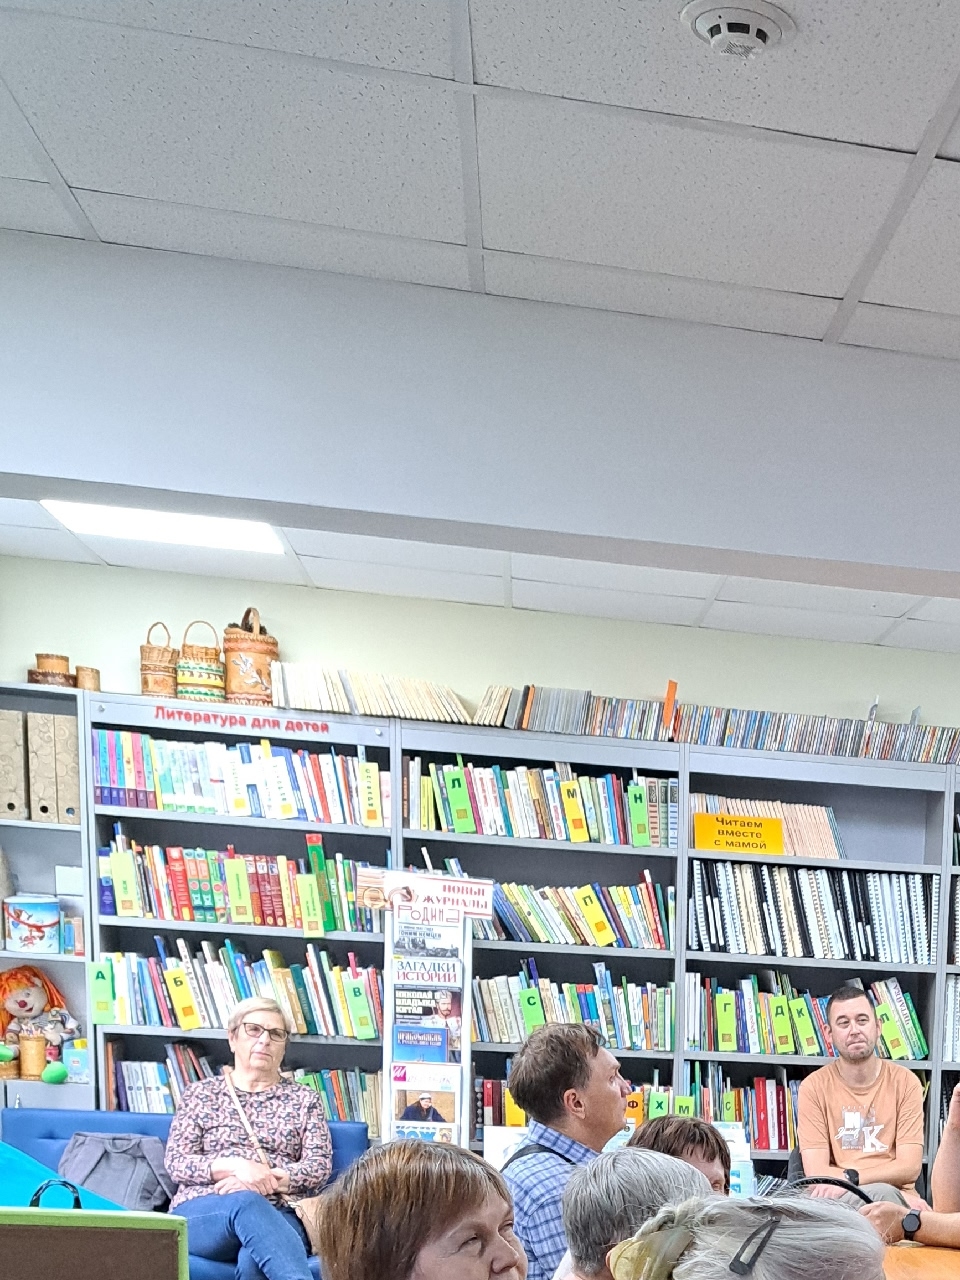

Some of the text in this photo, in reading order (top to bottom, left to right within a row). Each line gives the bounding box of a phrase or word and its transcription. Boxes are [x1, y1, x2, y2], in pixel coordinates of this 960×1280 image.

[155, 706, 330, 733] Литература для детей
[451, 778, 462, 789] Л
[566, 788, 577, 799] М
[633, 793, 643, 804] Н
[716, 817, 763, 828] Читаем
[717, 829, 762, 838] вместе
[725, 841, 766, 849] мамой
[422, 895, 488, 909] ЖУРНАЛЫ
[582, 895, 594, 906] П
[397, 961, 456, 973] ЗАГАДКИ
[95, 970, 106, 981] А
[397, 971, 457, 983] ИСТОРИИ
[173, 976, 183, 987] Б
[352, 987, 362, 997] В
[526, 996, 537, 1006] С
[723, 1003, 731, 1012] Г
[775, 1005, 785, 1017] Д
[796, 1008, 805, 1017] К
[627, 1100, 638, 1109] Ф
[655, 1101, 664, 1110] Х
[678, 1105, 690, 1114] М
[725, 1101, 731, 1111] С
